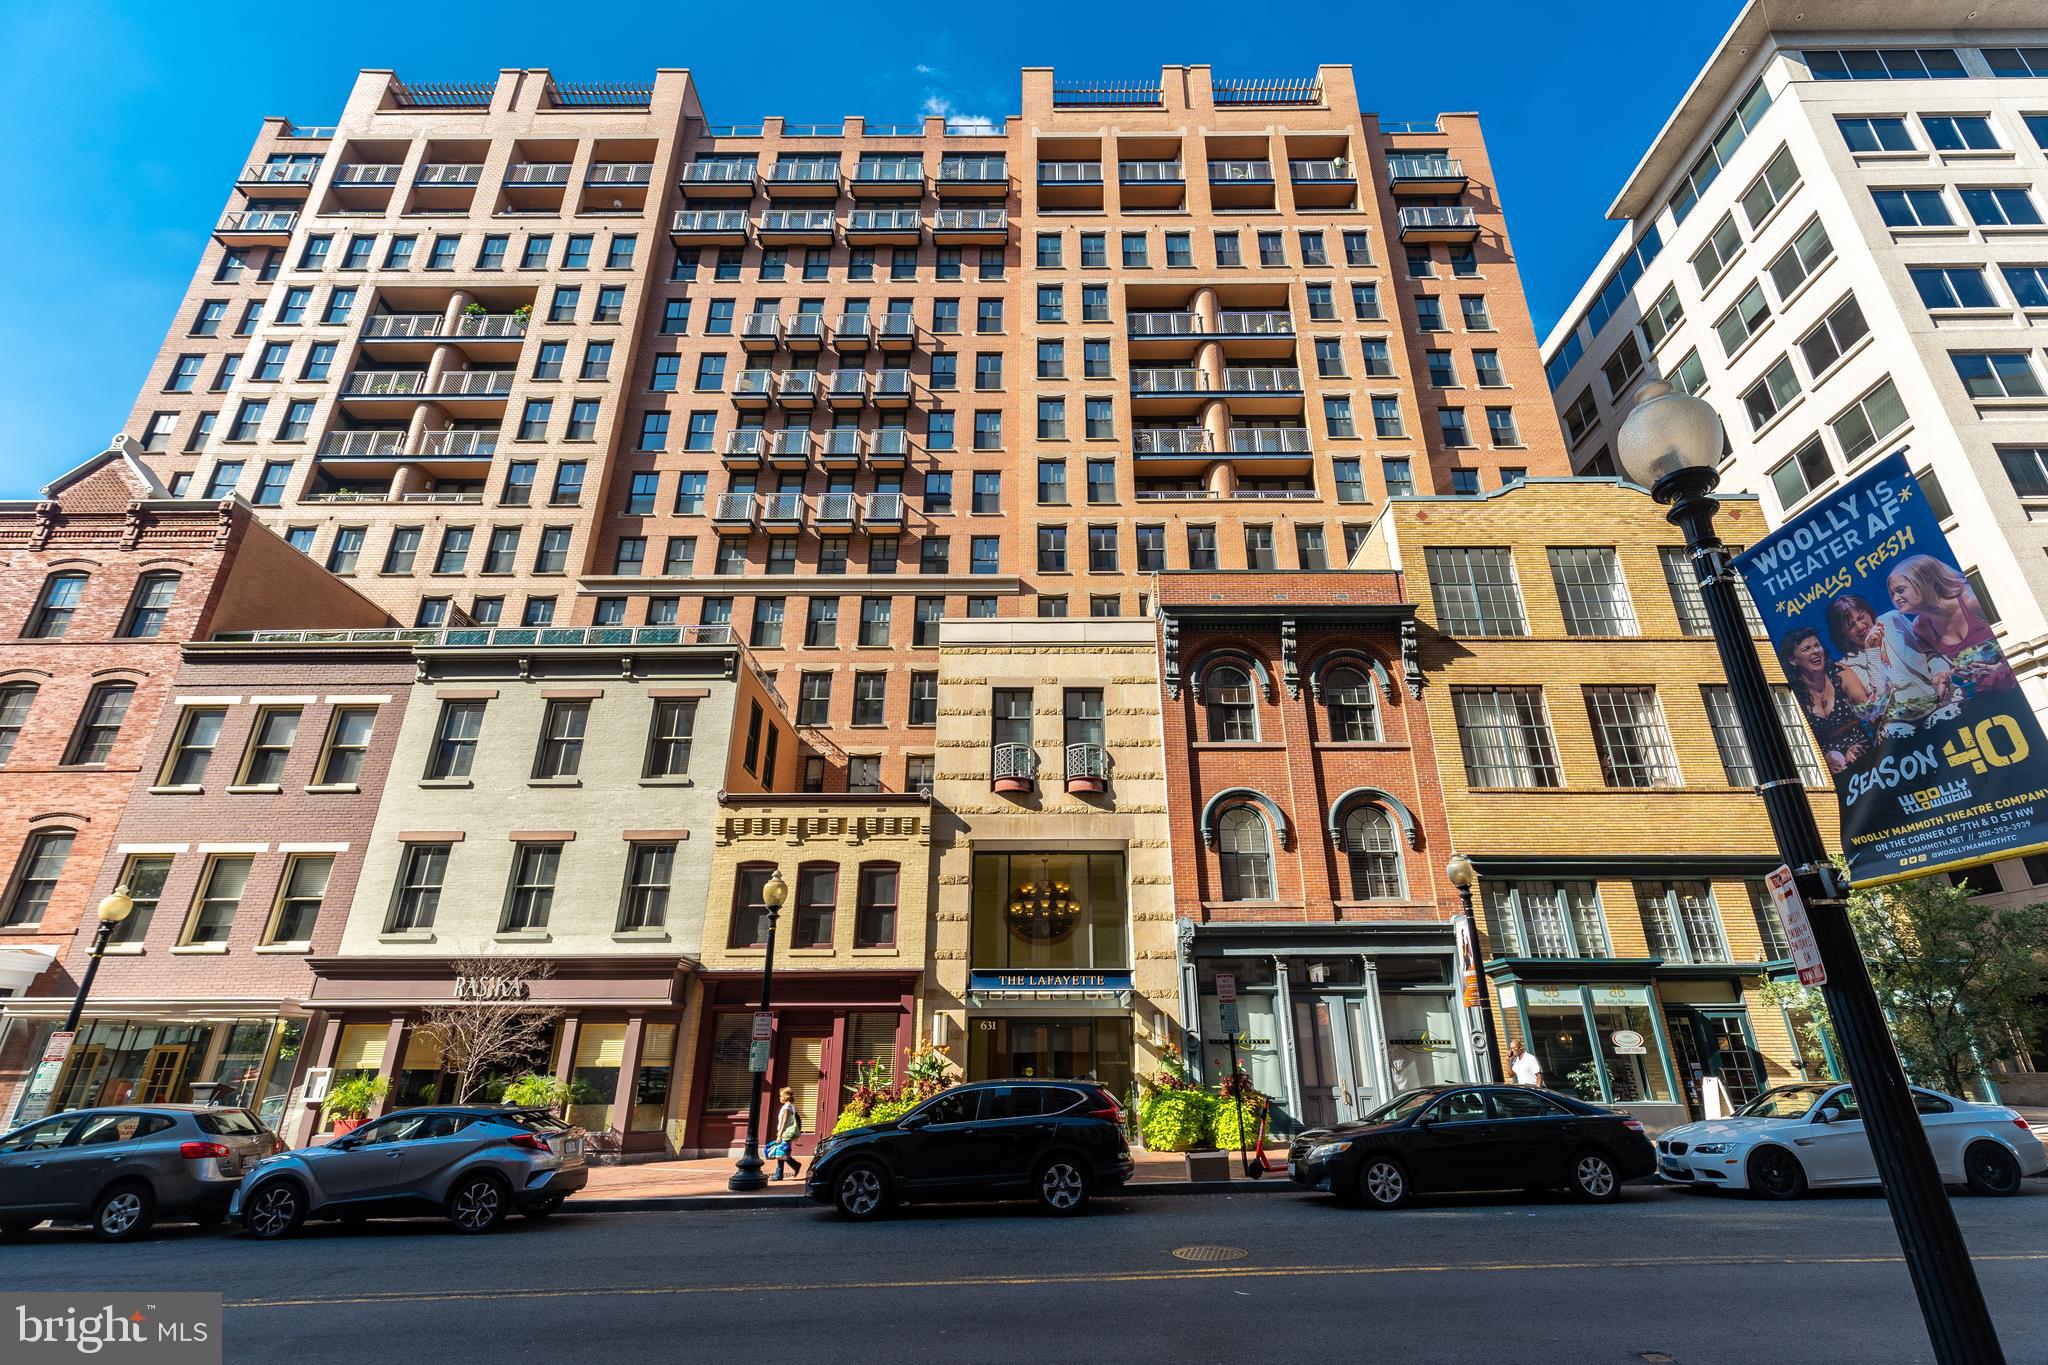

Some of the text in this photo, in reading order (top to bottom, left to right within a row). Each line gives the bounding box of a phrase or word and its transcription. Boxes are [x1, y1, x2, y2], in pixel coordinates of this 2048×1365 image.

[1751, 480, 1894, 576] WOOLLY IS
[1762, 529, 1863, 596] THEATER
[1854, 526, 1915, 578] FRESH
[1846, 714, 2029, 806] SEASON 40
[1851, 829, 1890, 846] WOOLLY
[1891, 815, 1944, 836] MAMMOTH
[1944, 802, 1994, 823] THEATRE
[1875, 806, 2034, 852] ON THE CORNER OF 7TH & D ST NW
[1885, 835, 1964, 859] WOOLLYMAMMOTH.NET
[1977, 820, 2031, 838] 202-393-3939
[1931, 834, 2017, 858] @WOOLLYMAMMOTHTC
[454, 976, 521, 999] RASIKA
[999, 975, 1105, 986] THE LAFAYETTE
[980, 1020, 997, 1030] 631
